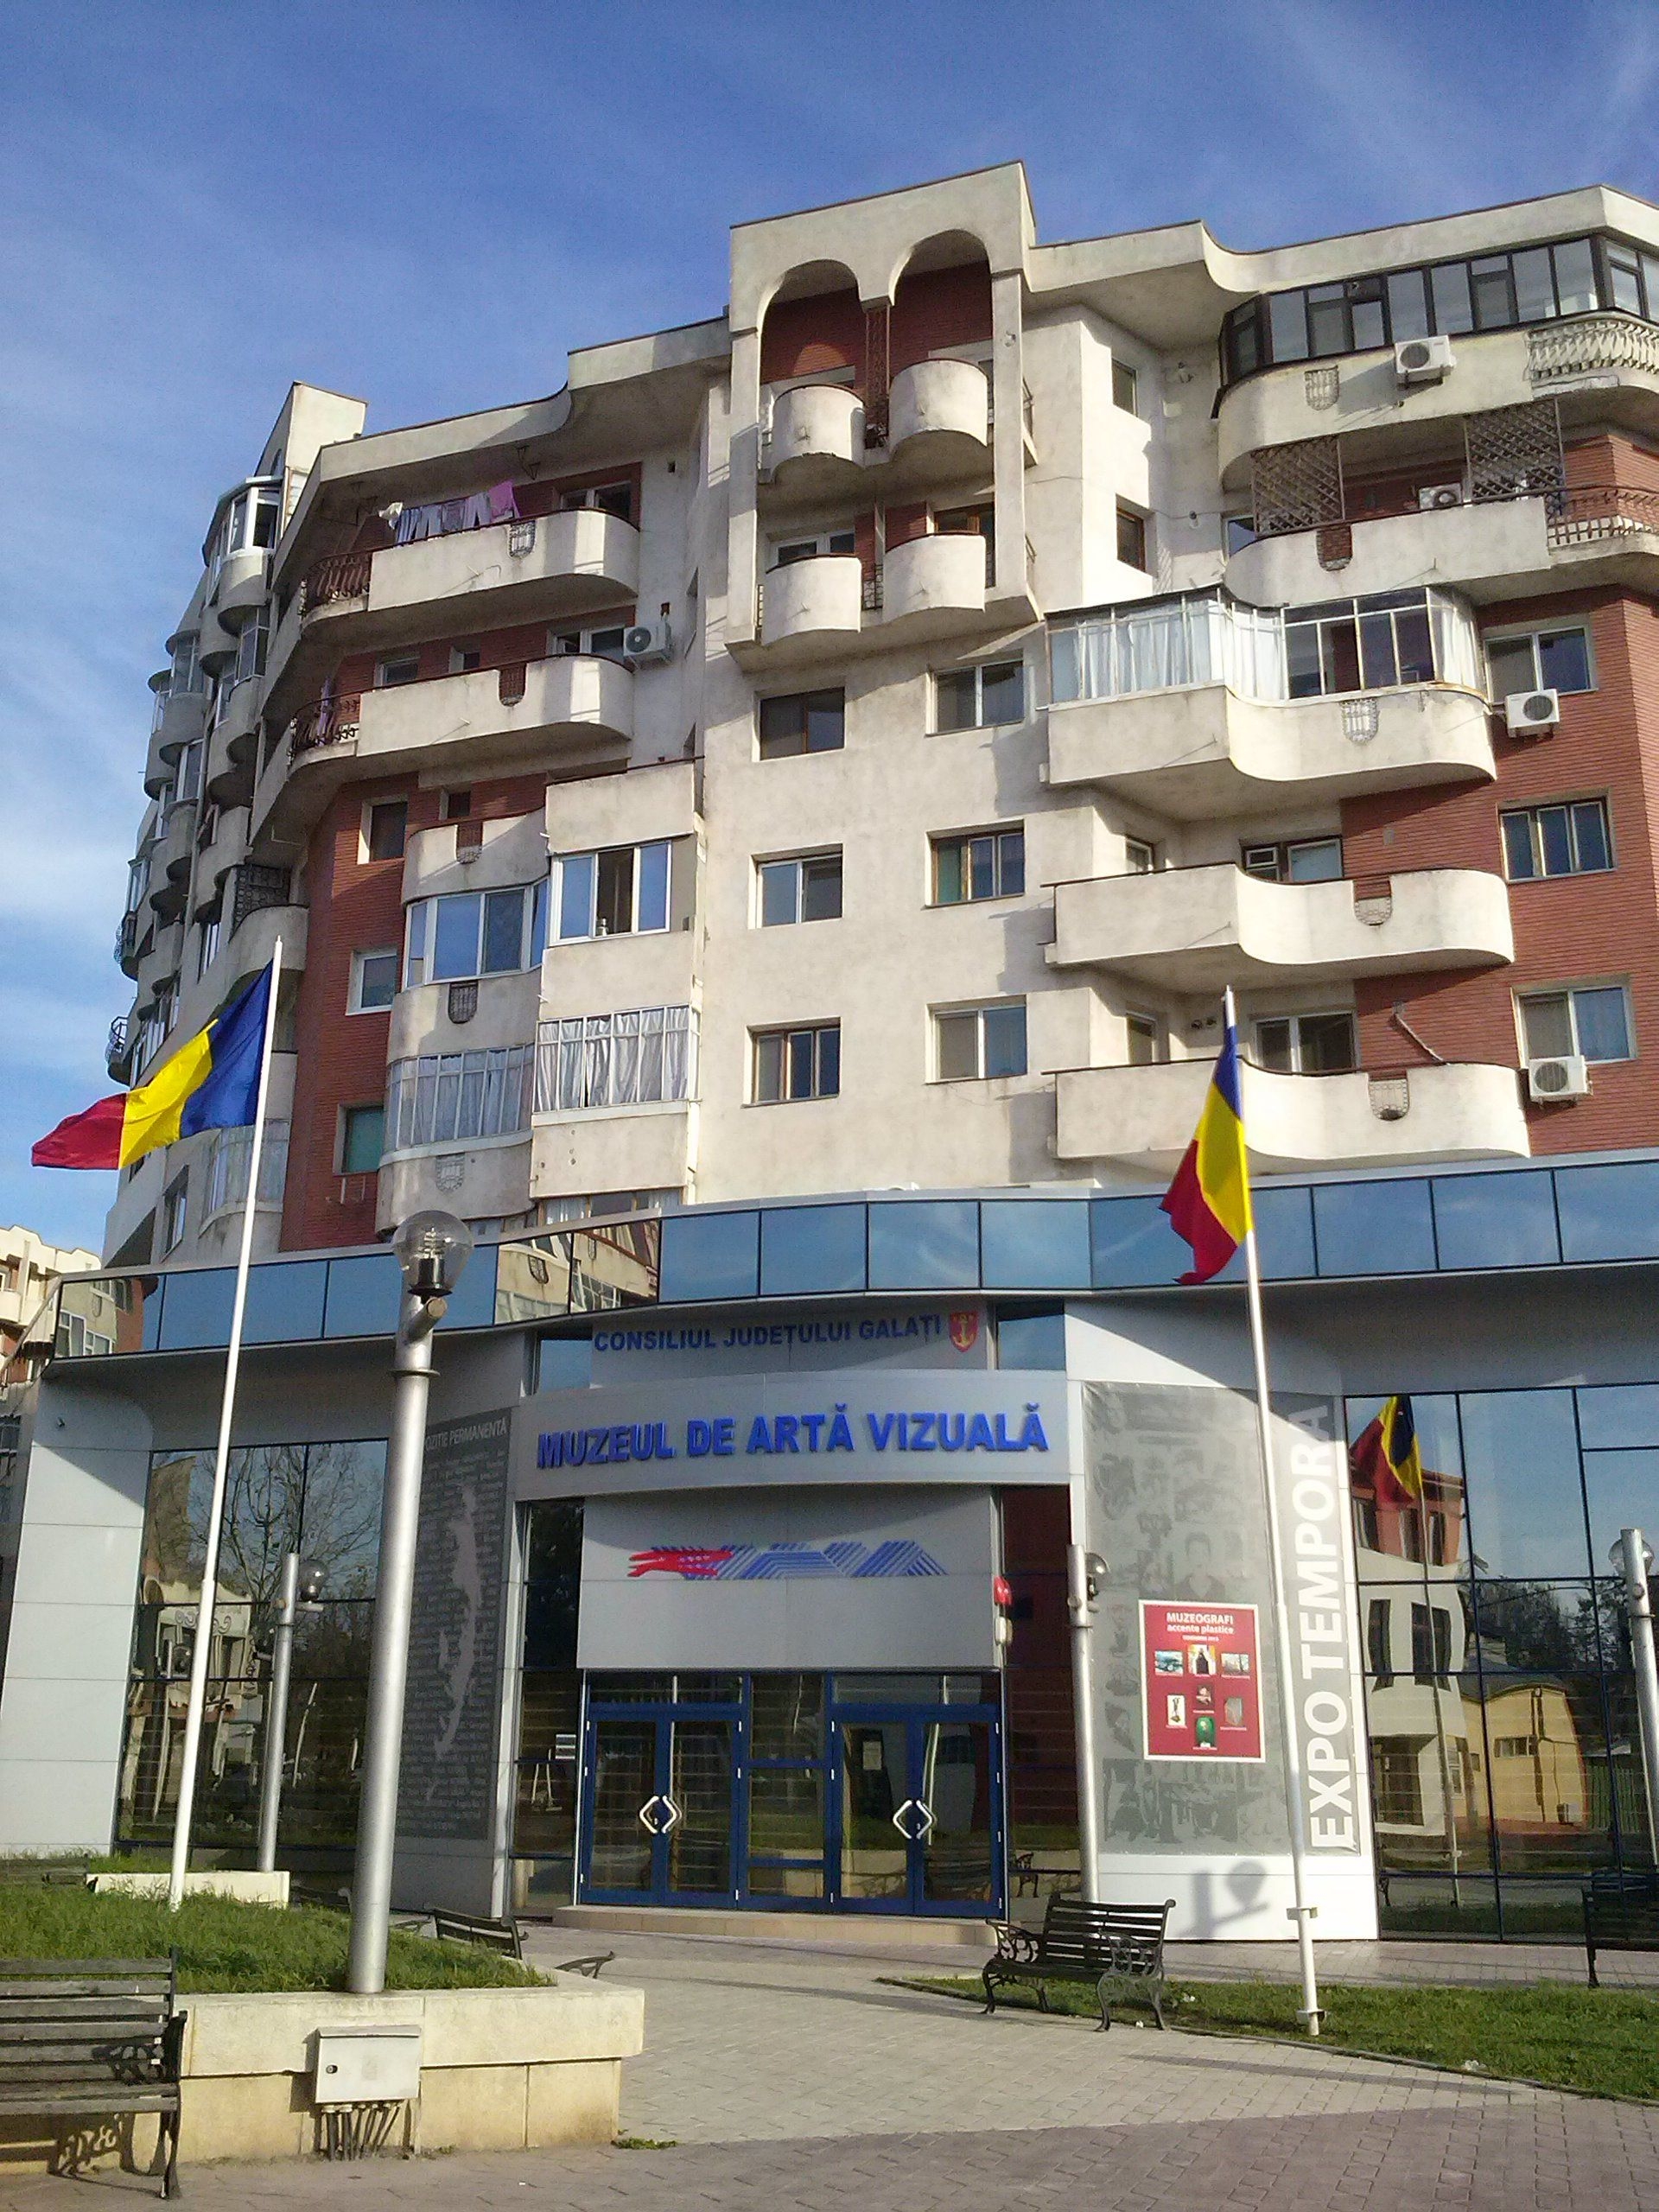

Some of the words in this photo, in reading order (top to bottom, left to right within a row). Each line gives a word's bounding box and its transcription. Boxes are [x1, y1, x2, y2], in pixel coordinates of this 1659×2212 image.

[594, 1329, 716, 1352] CONSILIUL
[536, 1421, 677, 1469] MUZEUL
[686, 1416, 735, 1458] DE
[746, 1402, 856, 1453] ARTĂ
[866, 1402, 1051, 1452] VIZUALĂ
[1287, 1404, 1344, 1679] TEMPORA
[1166, 1612, 1235, 1625] MUZEOGRAFI
[1166, 1624, 1200, 1633] accente
[1200, 1624, 1235, 1635] plastice
[1304, 1691, 1355, 1847] EXPO
